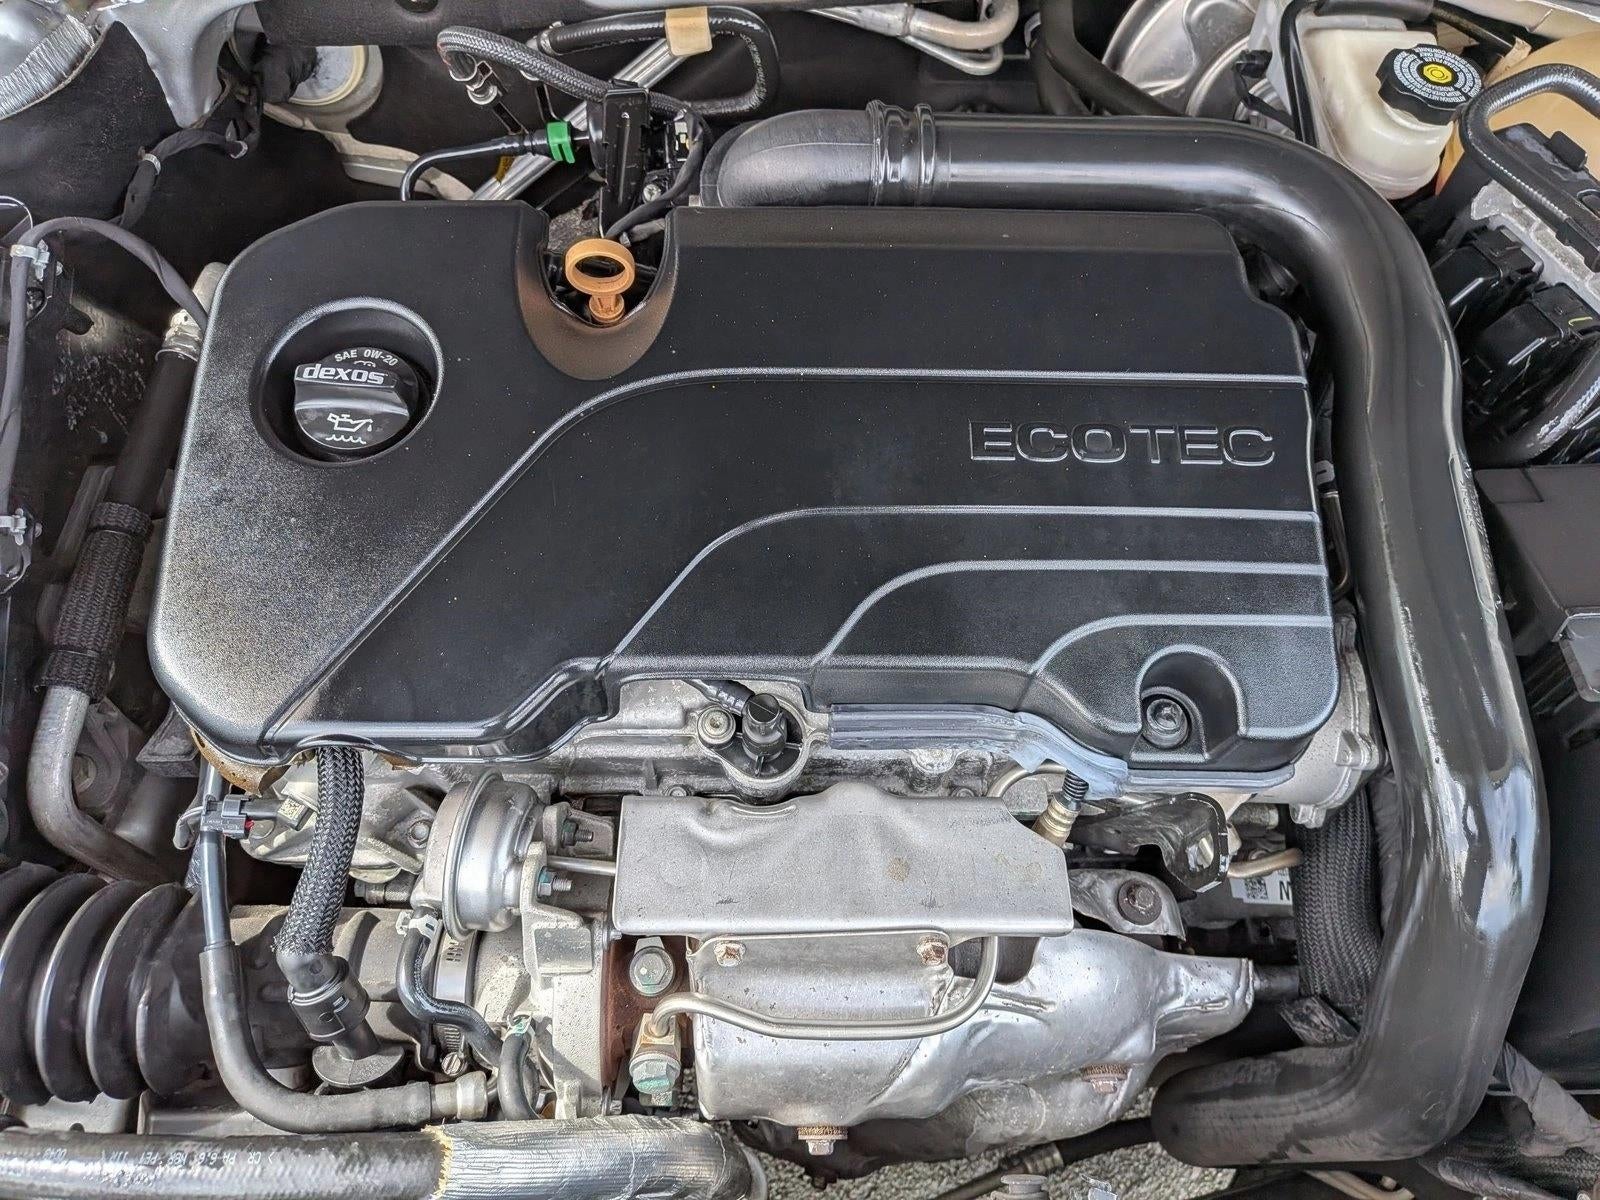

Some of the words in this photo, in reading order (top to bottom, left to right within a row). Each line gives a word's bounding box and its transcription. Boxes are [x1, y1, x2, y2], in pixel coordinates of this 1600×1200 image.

[334, 349, 358, 362] SAE
[363, 349, 399, 367] 0W-20
[302, 363, 385, 385] dexos
[967, 420, 1277, 466] ECOTEC
